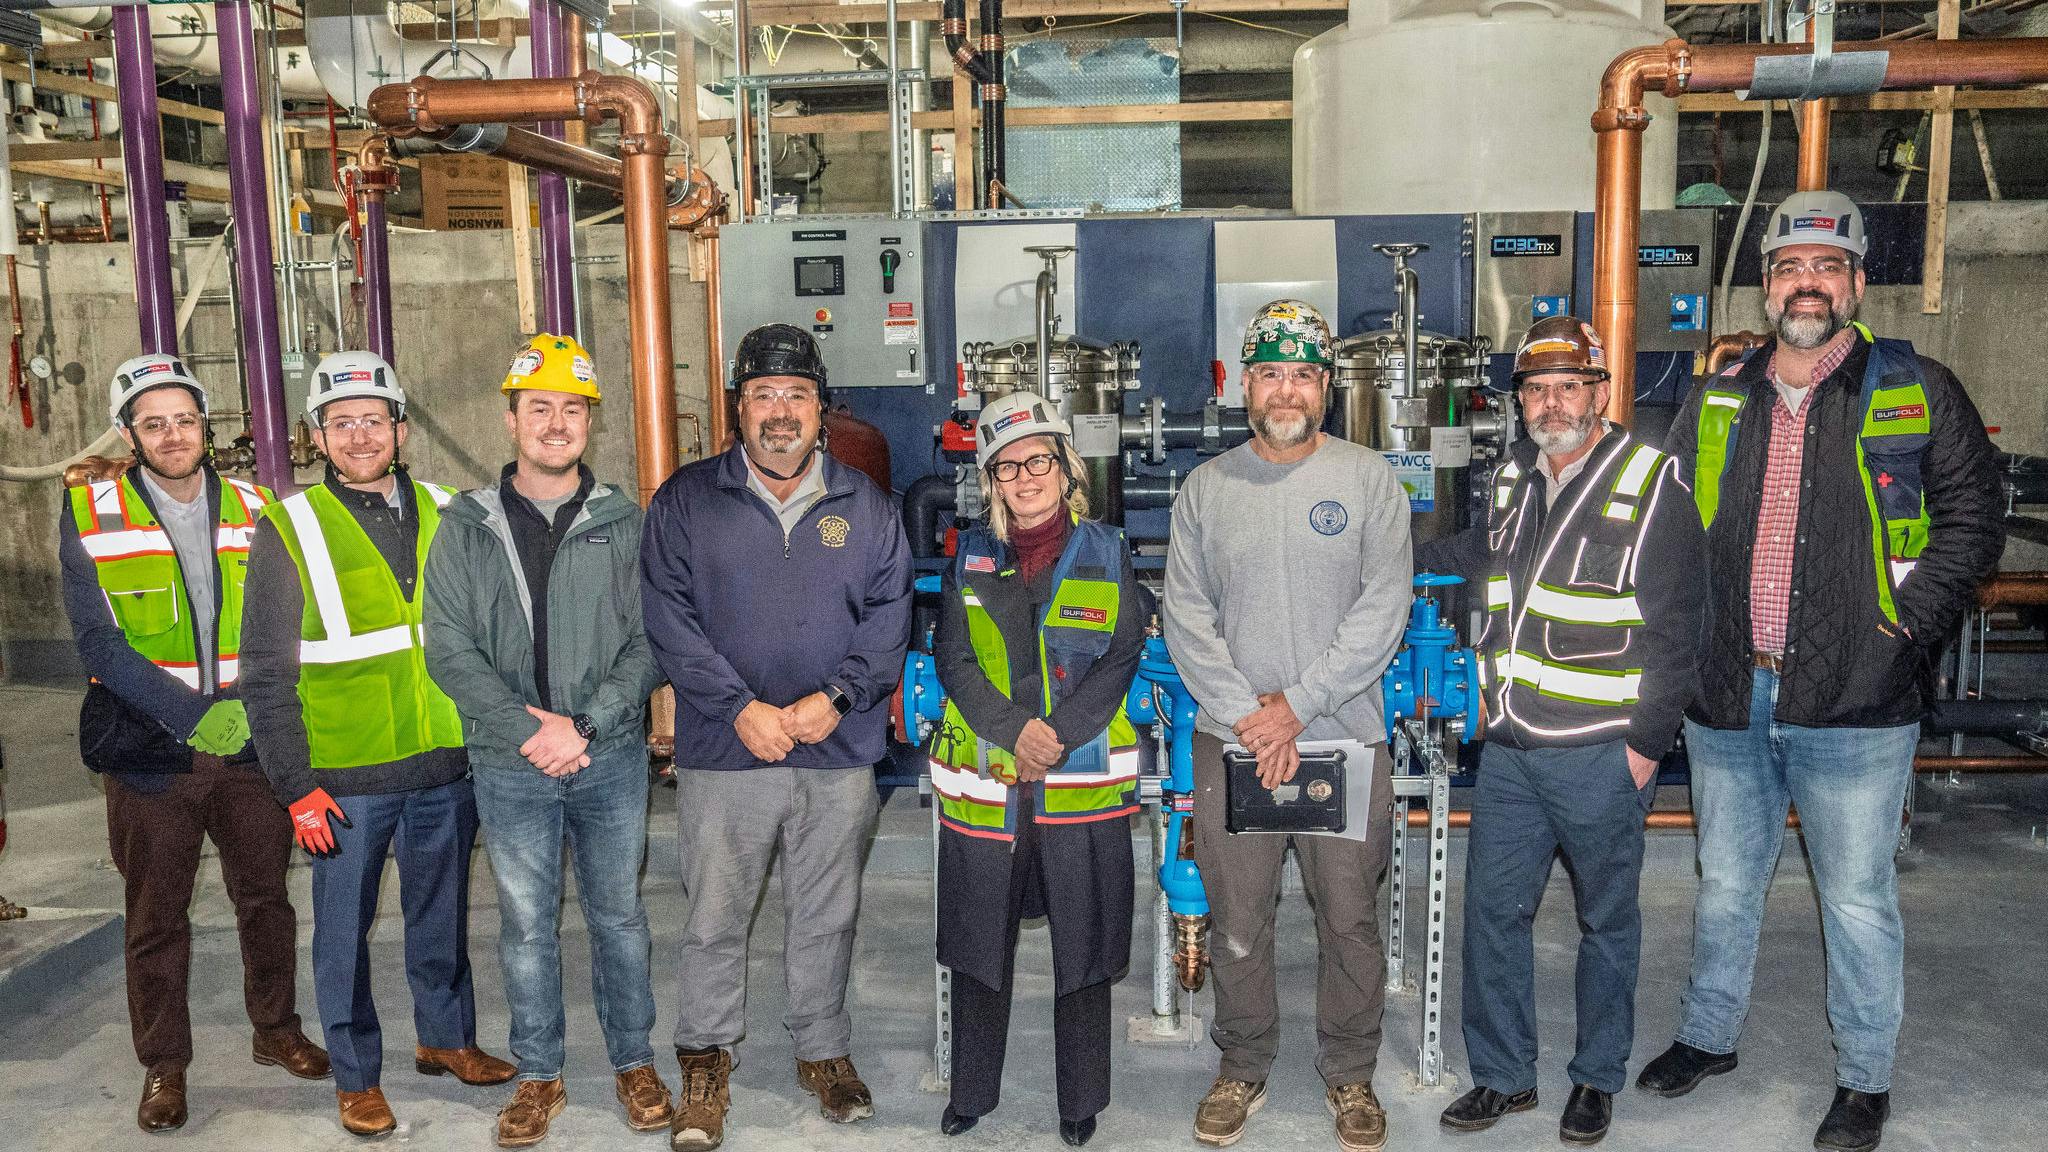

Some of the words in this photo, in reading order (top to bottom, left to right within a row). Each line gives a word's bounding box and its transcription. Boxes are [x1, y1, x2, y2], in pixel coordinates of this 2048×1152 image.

[448, 219, 503, 229] MANSON
[135, 365, 167, 377] SUFFOLK
[335, 373, 368, 381] SUFFOLK
[1876, 408, 1921, 418] SUFFOLK
[996, 413, 1028, 429] SUFFOLK
[1400, 455, 1431, 467] WCC
[1063, 609, 1103, 619] SUFFOLK
